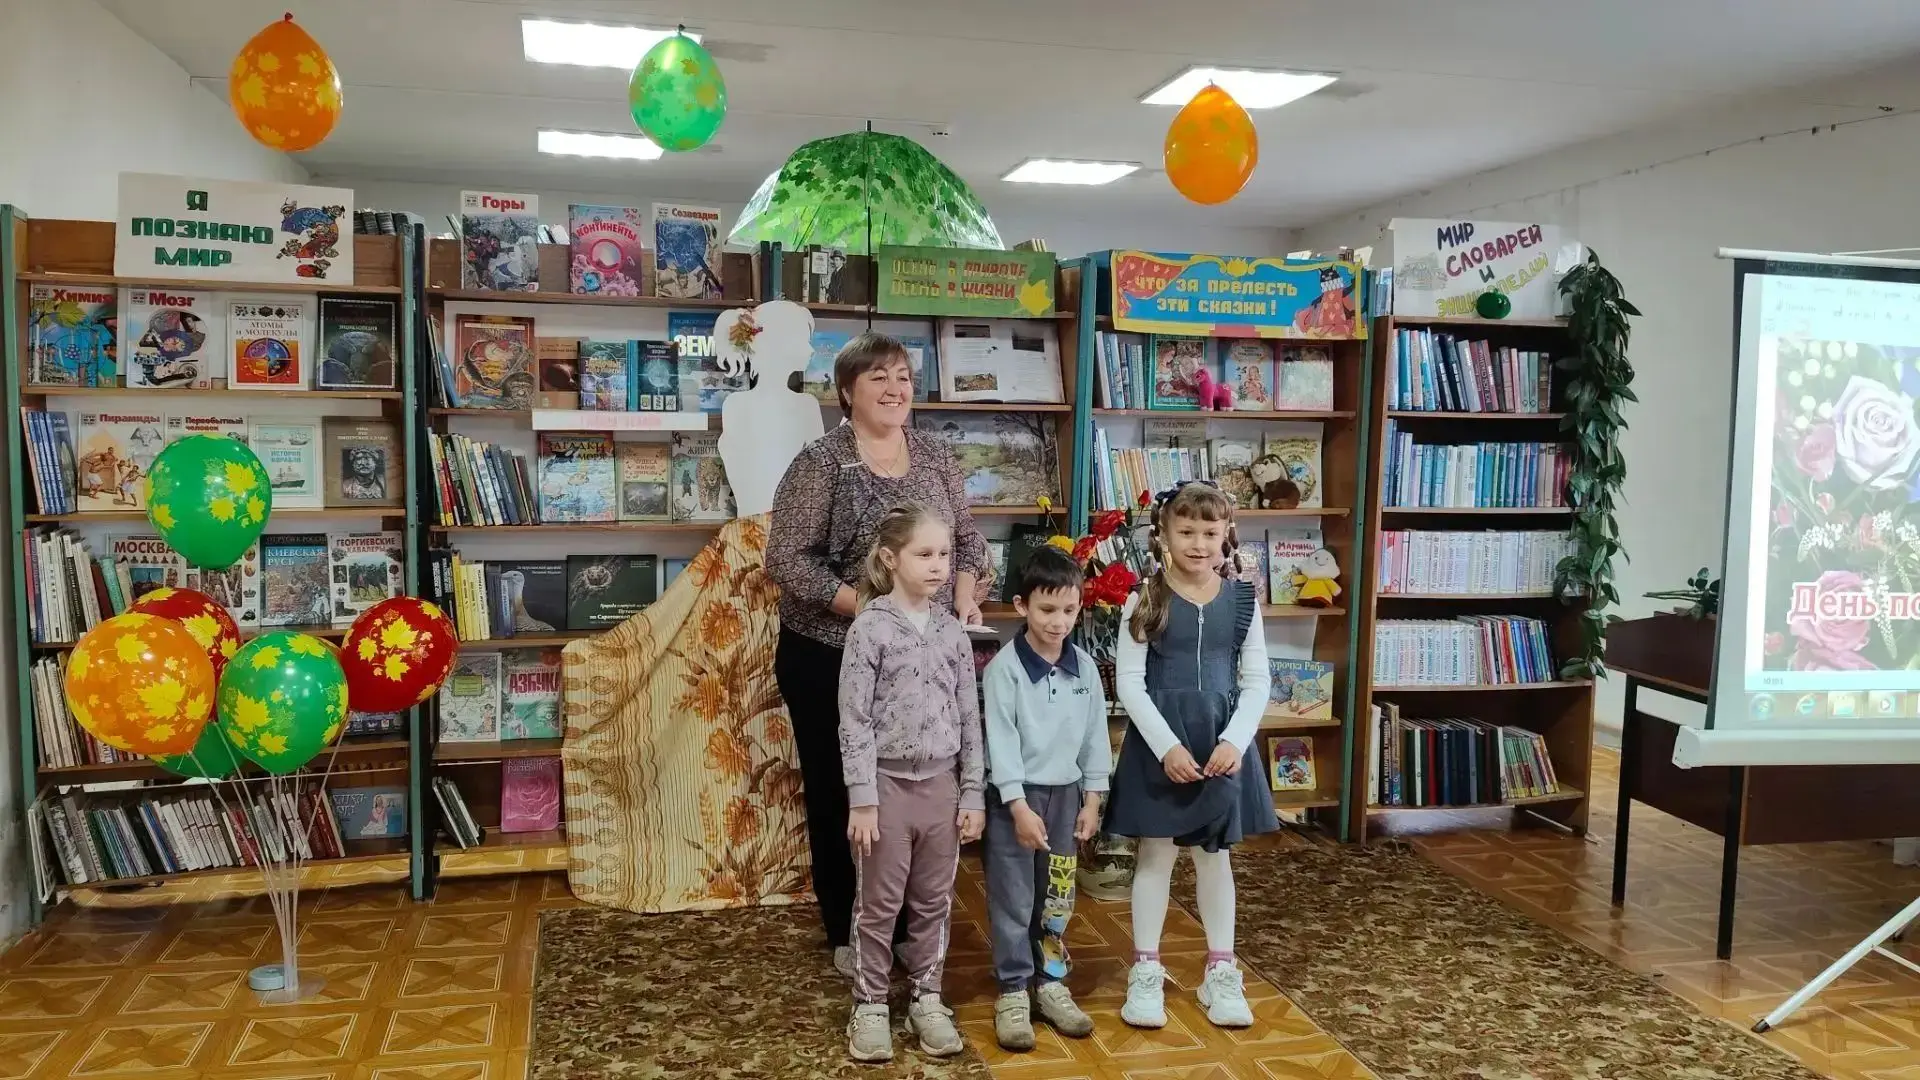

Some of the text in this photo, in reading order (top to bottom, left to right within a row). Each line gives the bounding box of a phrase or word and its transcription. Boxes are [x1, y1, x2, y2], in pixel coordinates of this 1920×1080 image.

[186, 190, 209, 212] Я
[482, 195, 525, 213] Горы
[671, 207, 719, 221] Созвездия
[131, 216, 274, 245] ПОЗНАЮ
[576, 221, 638, 241] КОНТИНЕНТЫ
[1437, 222, 1475, 250] МИР
[154, 246, 233, 267] МИР
[1446, 223, 1543, 278] СЛОВАРЕЙ
[892, 258, 1028, 280] ОСЕНЬ В ПРИРОДЕ
[1479, 264, 1495, 283] И
[891, 278, 1016, 300] ОСЕНЬ В ЖИЗНИ
[1135, 276, 1166, 291] ЧТО
[1176, 279, 1199, 292] ЗА
[53, 288, 113, 304] Химия
[149, 292, 195, 307] Мозг
[1157, 298, 1189, 312] ЭТИ
[249, 321, 285, 330] АТОМЫ
[245, 329, 298, 338] МОЛЕКУЛЫ
[674, 335, 717, 357] ЗЕМ
[100, 414, 161, 425] Пирамиды
[185, 416, 244, 426] Первобытный
[185, 424, 219, 432] человек
[548, 441, 606, 452] ЗАГАДКИ
[577, 453, 606, 461] МОРЯ
[114, 541, 177, 554] МОСКВА
[336, 537, 396, 547] ГЕОРГИЕВСКИЕ
[267, 548, 323, 557] КИЕВСКАЯ
[267, 557, 295, 566] РУСЬ
[1789, 583, 1877, 622] День
[1304, 661, 1325, 672] Ряба
